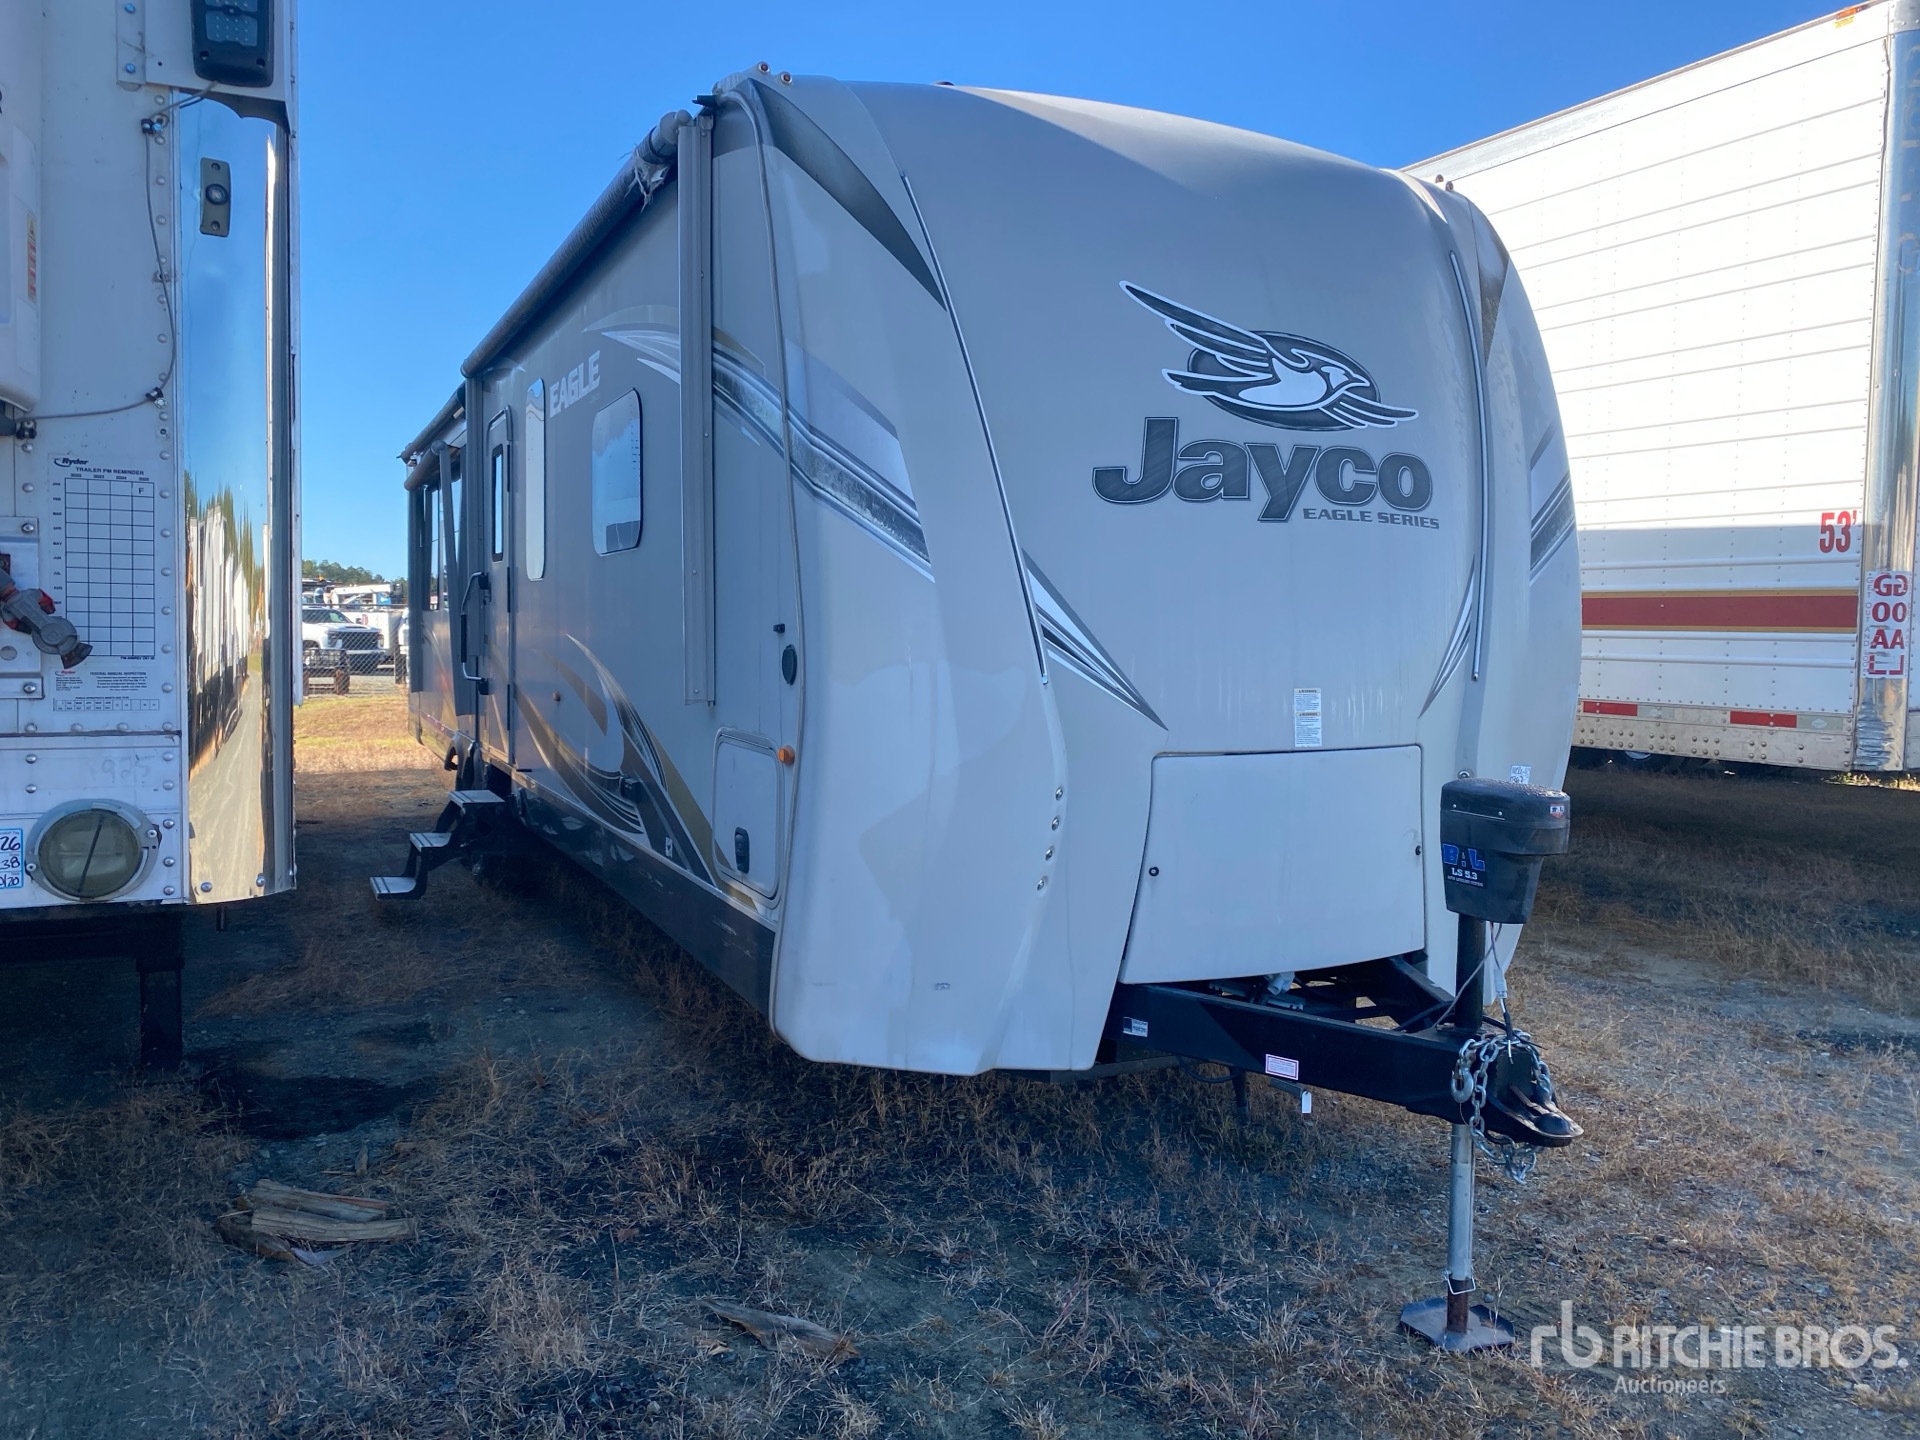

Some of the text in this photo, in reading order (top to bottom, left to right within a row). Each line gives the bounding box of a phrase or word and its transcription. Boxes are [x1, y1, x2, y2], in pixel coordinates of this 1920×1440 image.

[549, 349, 600, 418] EAGLE
[1092, 416, 1433, 523] Jayco
[1302, 508, 1440, 530] EAGLE SERIES
[1819, 509, 1857, 554] 53'
[1451, 867, 1463, 877] LS
